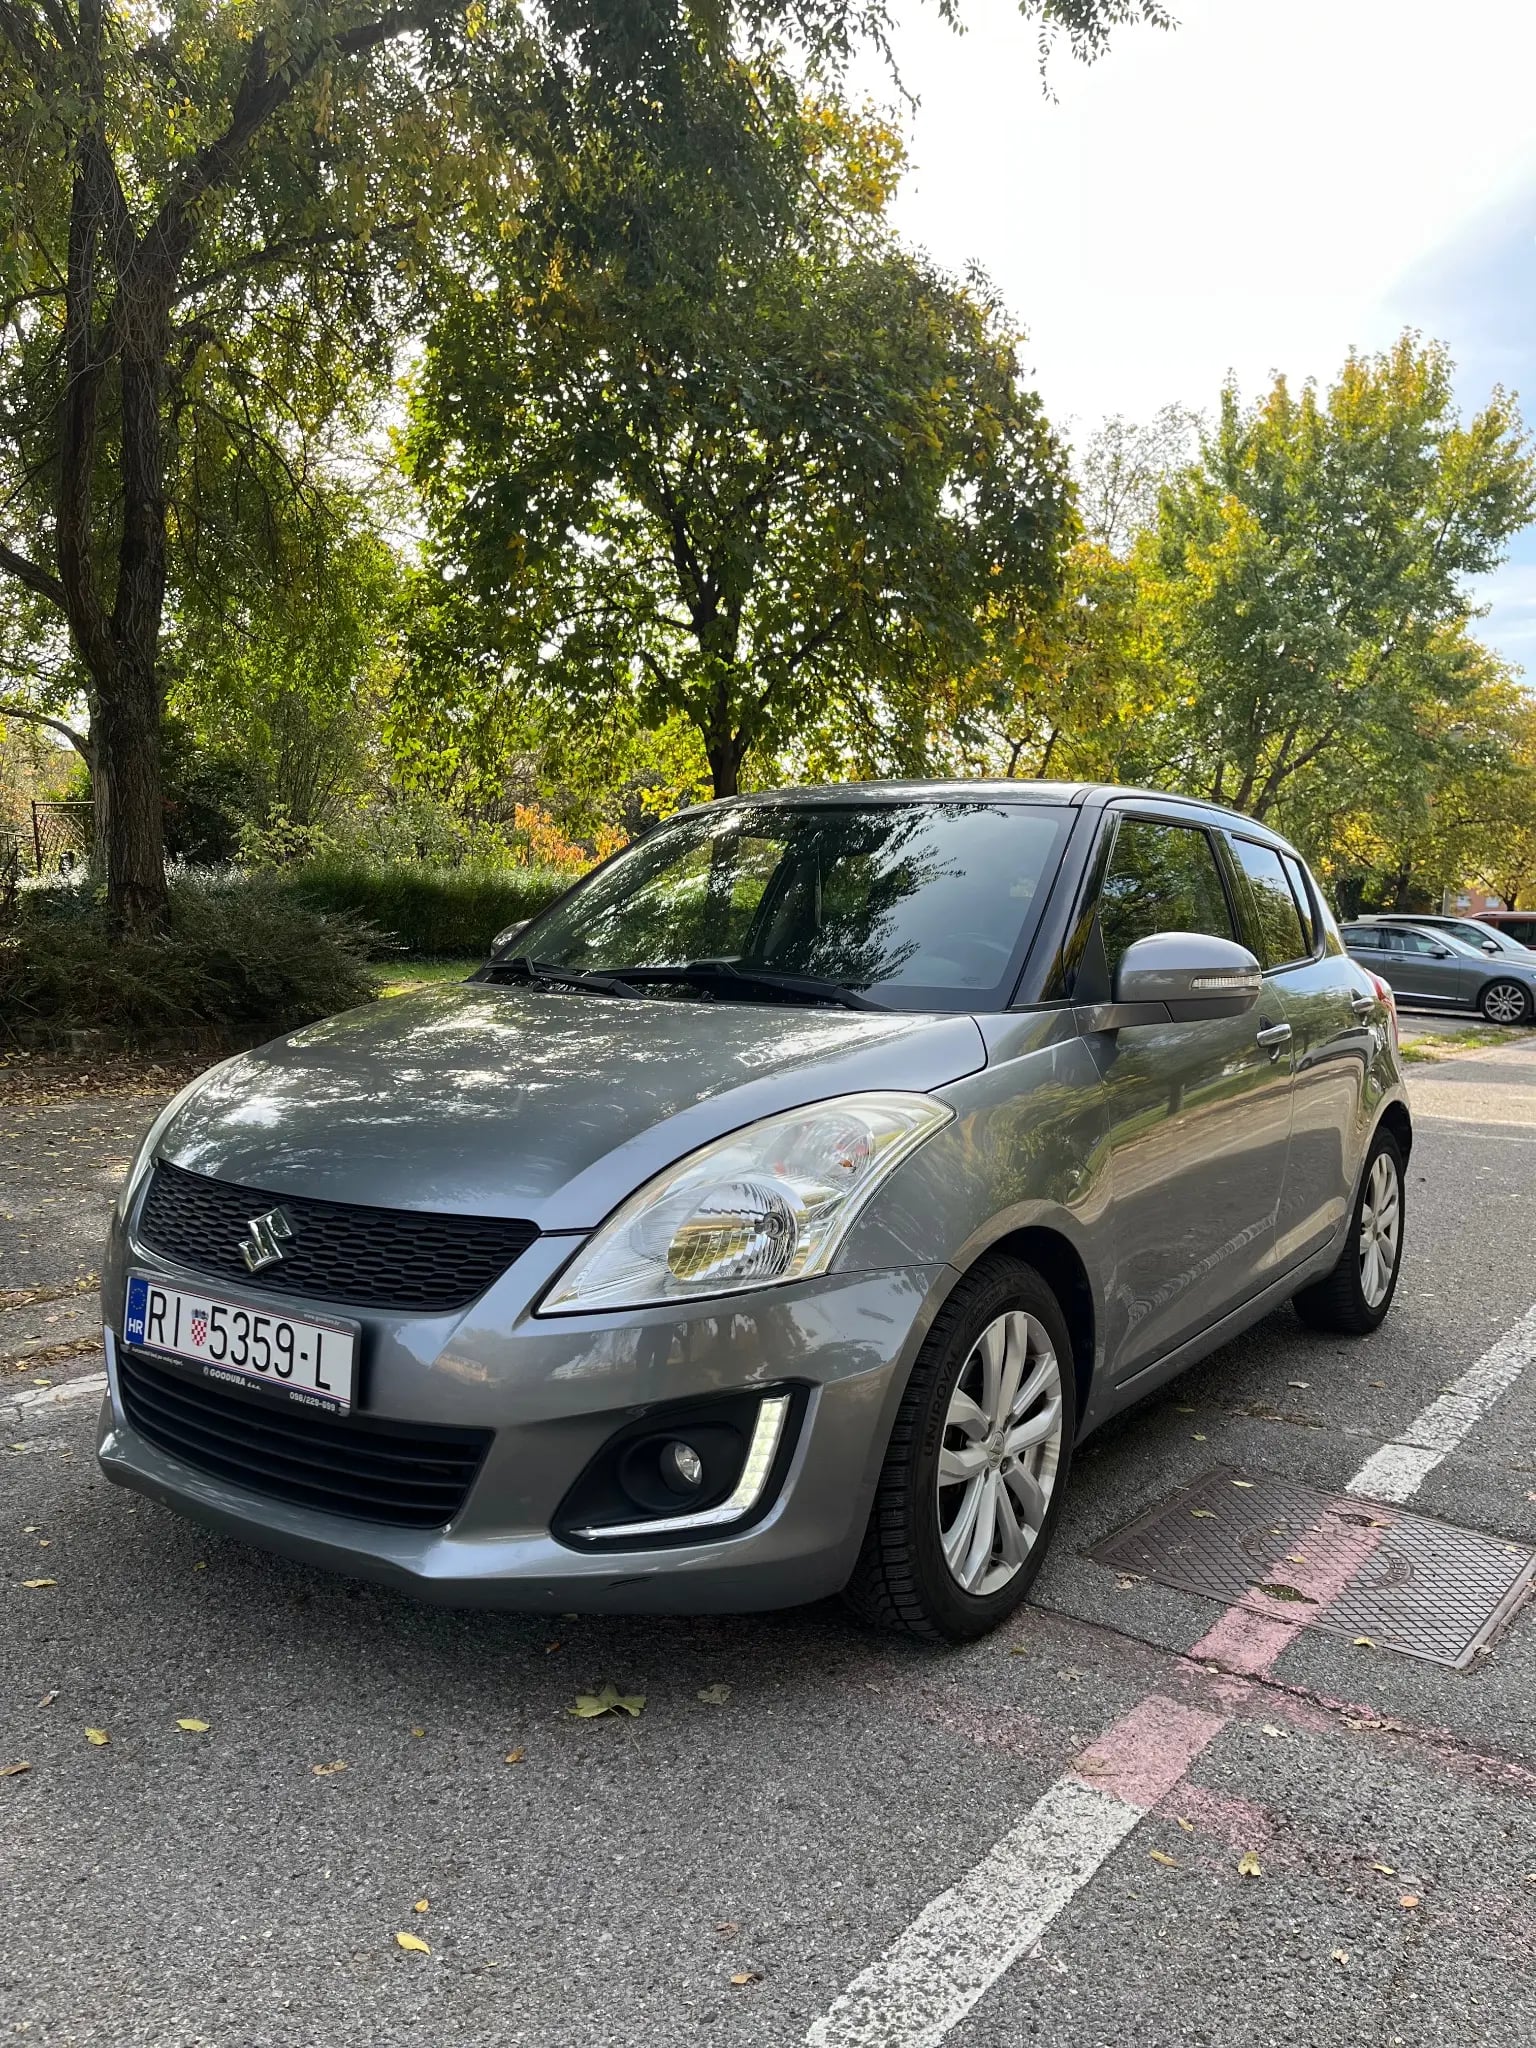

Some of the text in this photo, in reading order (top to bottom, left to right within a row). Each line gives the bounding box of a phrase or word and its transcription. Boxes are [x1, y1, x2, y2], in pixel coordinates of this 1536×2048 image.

[127, 1317, 143, 1336] HR
[147, 1290, 331, 1391] RI 5359-L
[209, 1368, 246, 1387] GOODURA
[923, 1348, 960, 1457] UNIROYAL
